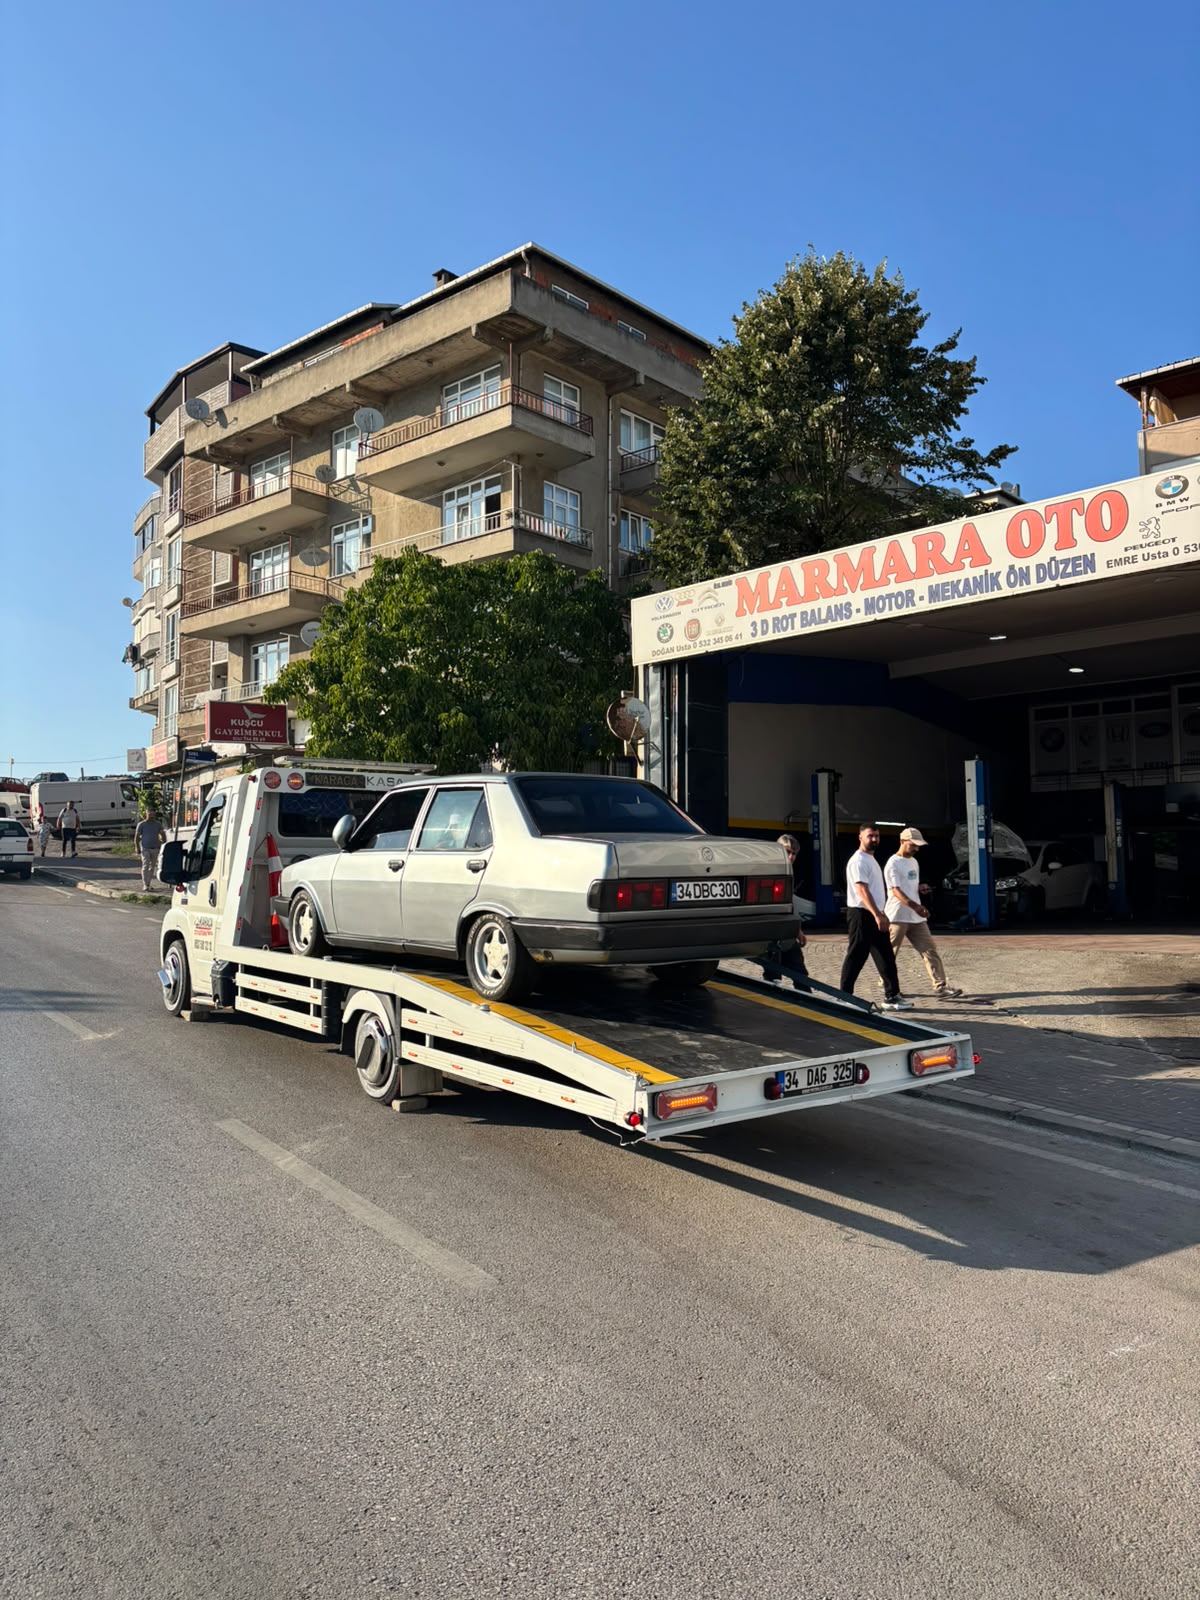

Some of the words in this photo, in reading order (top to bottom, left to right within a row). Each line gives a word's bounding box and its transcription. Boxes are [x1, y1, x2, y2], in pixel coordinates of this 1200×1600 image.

[1155, 496, 1190, 508] BMW
[735, 522, 992, 617] MARMARA
[1006, 489, 1129, 559] OTO
[1124, 536, 1178, 552] PEUGEOT
[1106, 554, 1139, 569] EMRE
[1142, 550, 1169, 562] Usta
[1172, 546, 1180, 556] 0
[1183, 543, 1200, 554] 53
[750, 620, 758, 638] 3
[761, 619, 769, 636] D
[772, 612, 797, 634] ROT
[800, 601, 853, 629] BALANS
[864, 588, 916, 616] MOTOR
[928, 569, 1002, 604] MEKANİK
[1006, 564, 1031, 588] ÖN
[1035, 552, 1096, 584] DÜZEN
[651, 646, 675, 657] DOĞAN
[676, 644, 692, 652] Usta
[698, 639, 711, 647] 532
[230, 718, 264, 728] KUŞCU
[214, 728, 283, 738] GAYRİMENKUL
[785, 1071, 799, 1090] 34
[807, 1066, 827, 1087] DAG
[833, 1062, 852, 1082] 325
